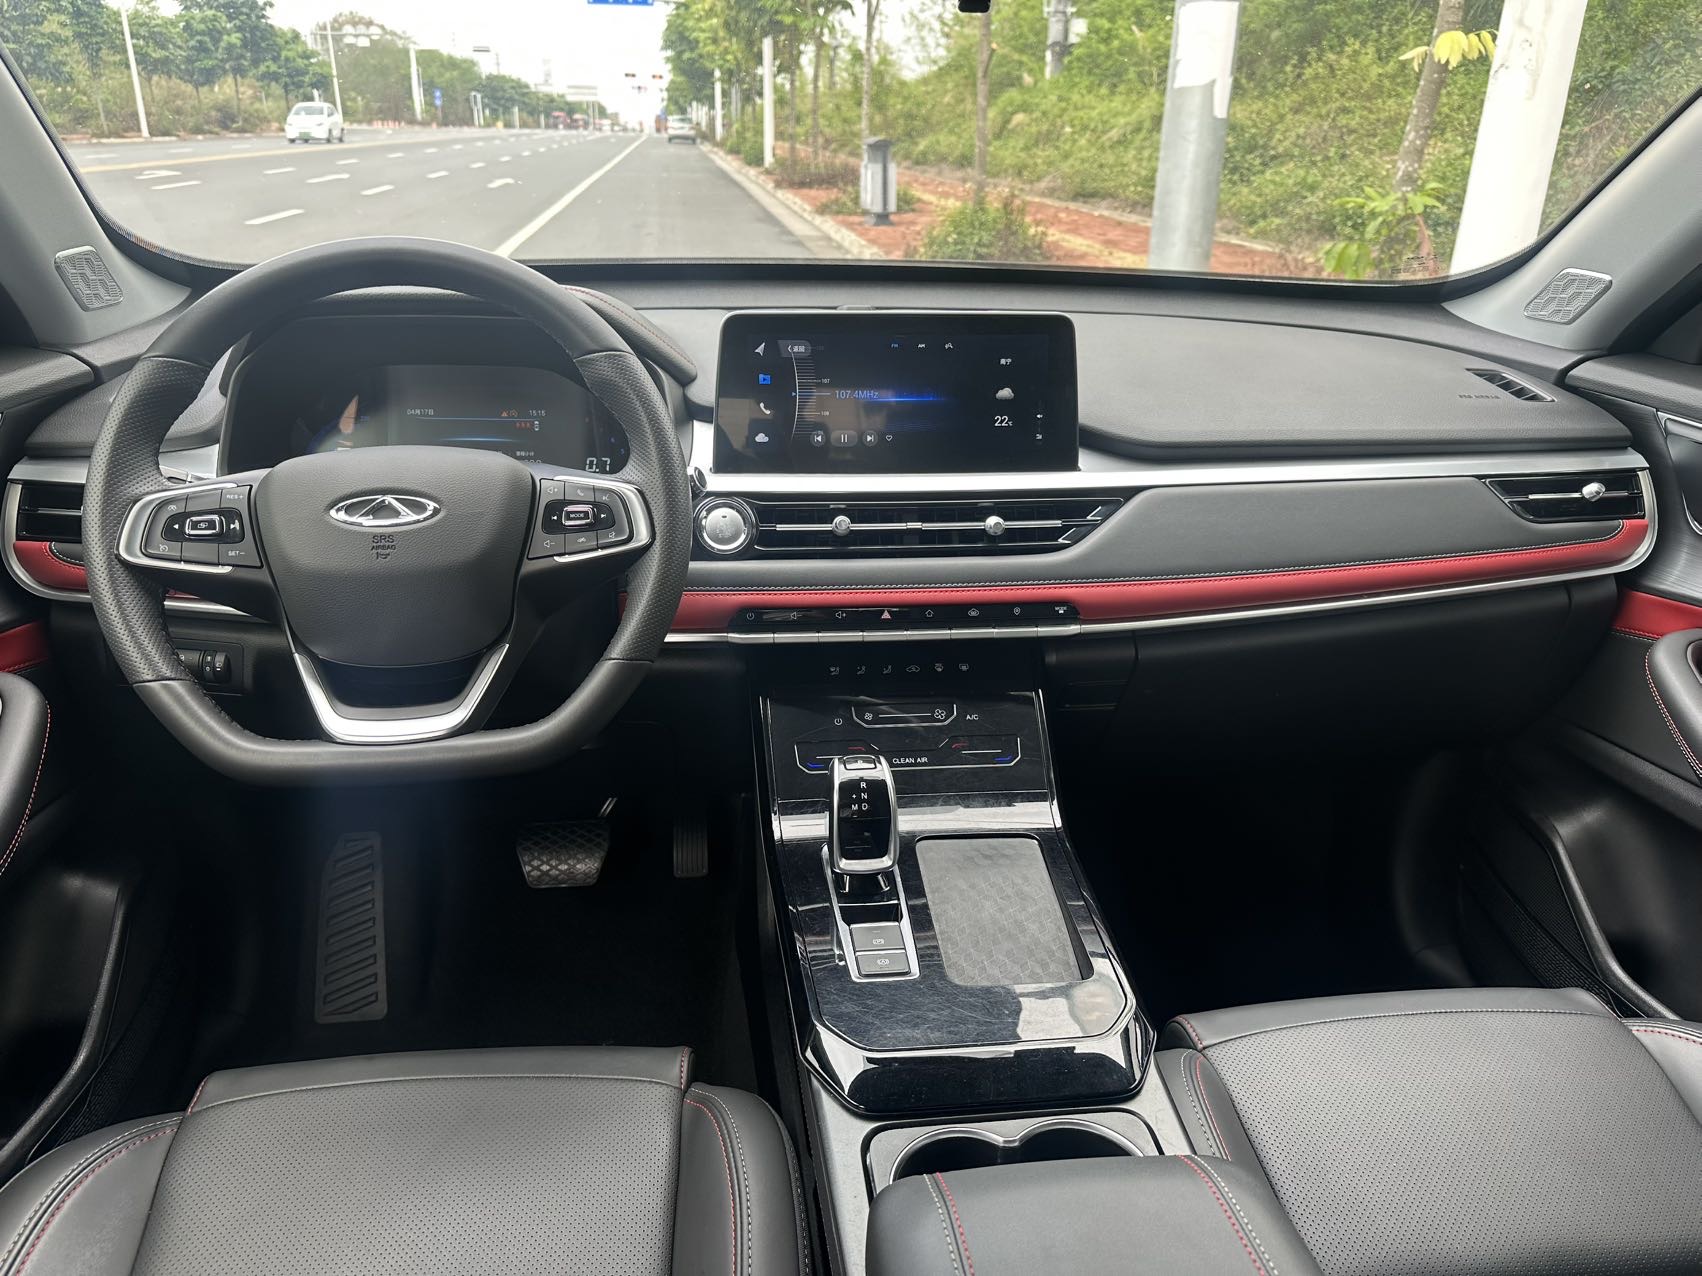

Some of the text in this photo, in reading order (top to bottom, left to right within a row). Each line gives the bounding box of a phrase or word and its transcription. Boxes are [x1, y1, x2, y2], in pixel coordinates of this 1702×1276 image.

[835, 390, 880, 399] 107.4MHz
[406, 408, 434, 416] 04月17日
[585, 457, 611, 472] 0.7
[372, 534, 395, 544] SRS
[860, 781, 867, 789] R
[861, 792, 868, 800] N
[851, 803, 868, 811] M D
